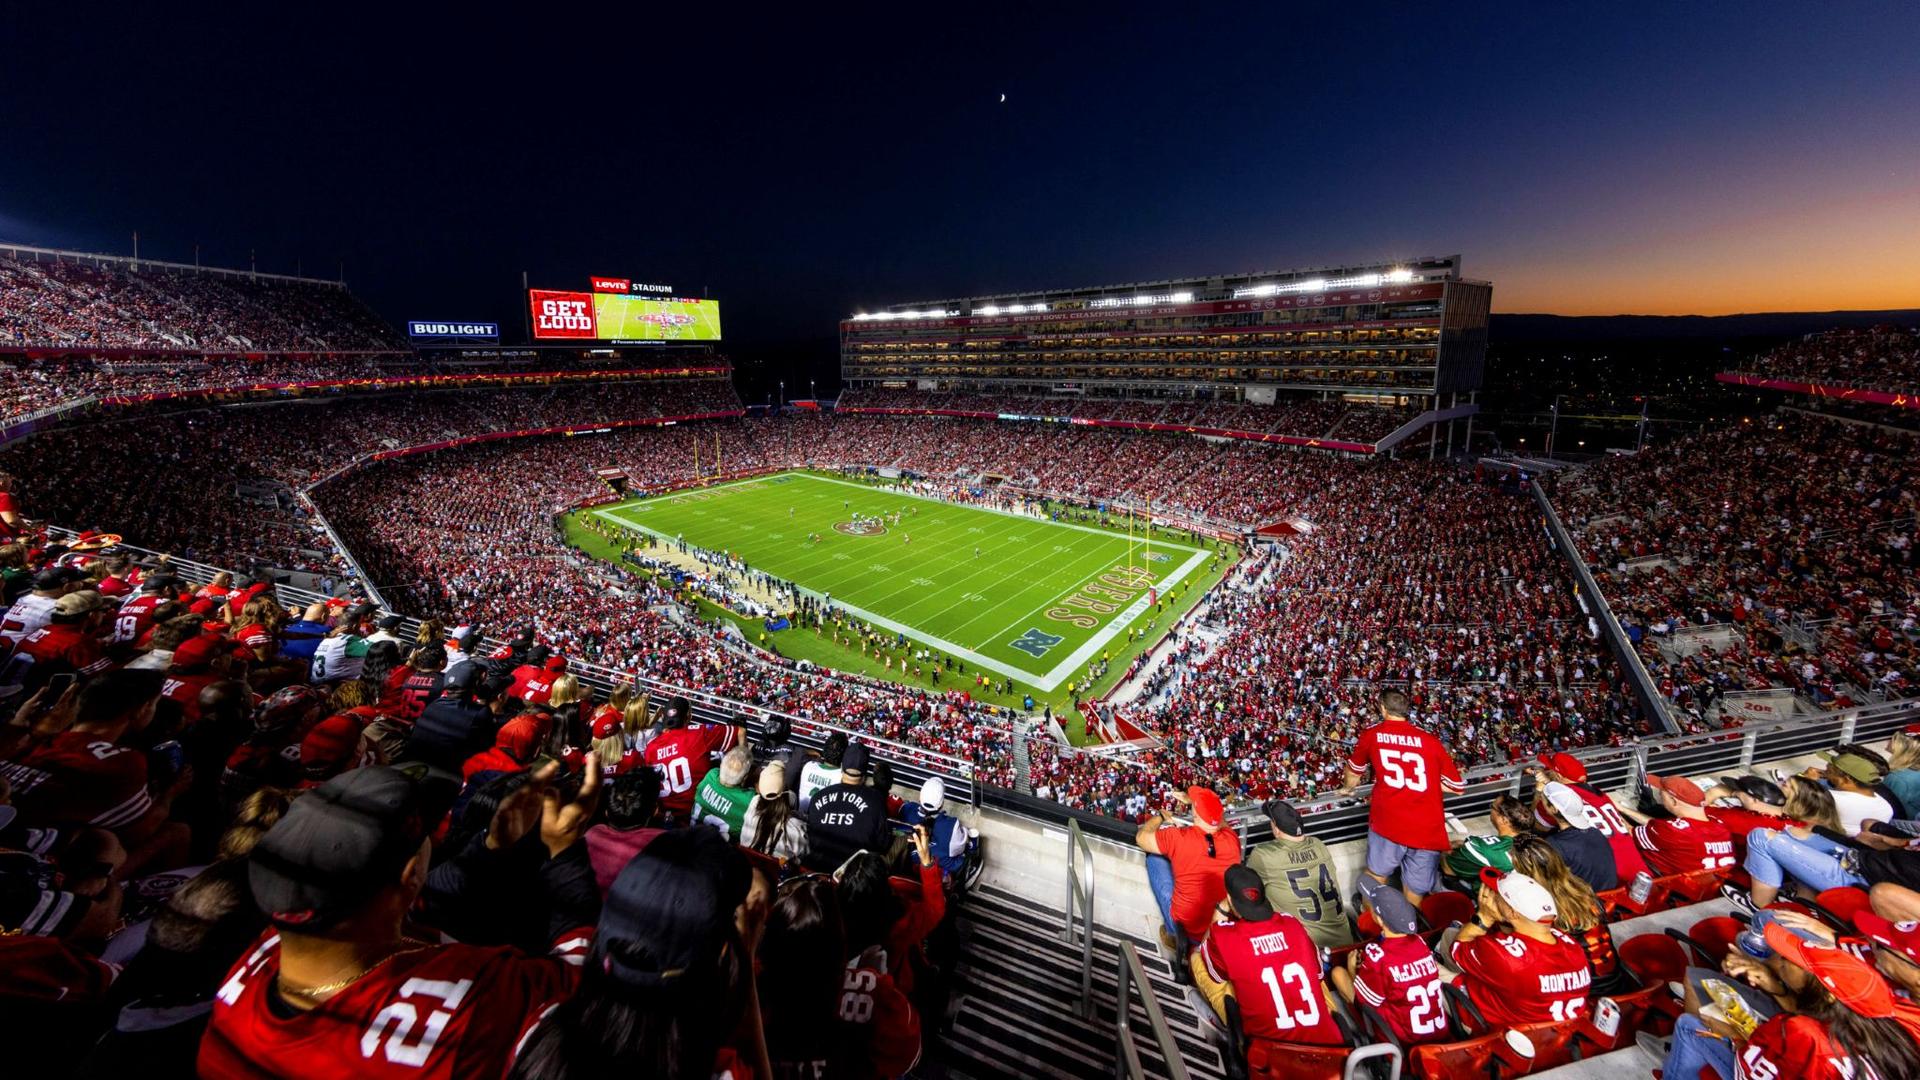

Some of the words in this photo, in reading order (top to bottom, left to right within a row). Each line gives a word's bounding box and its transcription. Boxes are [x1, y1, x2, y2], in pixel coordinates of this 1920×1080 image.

[632, 283, 673, 293] STADIUM
[542, 300, 586, 317] GET
[1070, 310, 1129, 319] CHAMPIONS
[414, 324, 449, 334] BUD
[450, 325, 494, 335] LIGHT
[539, 315, 592, 330] LOUD
[1376, 732, 1422, 748] BOWMAN
[657, 744, 679, 760] RICE
[1379, 749, 1427, 792] 53
[702, 784, 733, 815] NAMATH
[814, 792, 838, 811] NEW
[842, 793, 869, 813] YORK
[820, 812, 855, 826] JETS
[1288, 848, 1319, 864] WARNER
[1703, 841, 1733, 854] PURDY
[1286, 863, 1344, 921] 54
[1250, 932, 1289, 956] PURDY
[1538, 966, 1592, 993] MONTANA
[838, 970, 877, 1025] 85
[1261, 962, 1320, 1030] 13
[1406, 979, 1446, 1035] 23
[360, 976, 474, 1068] 21
